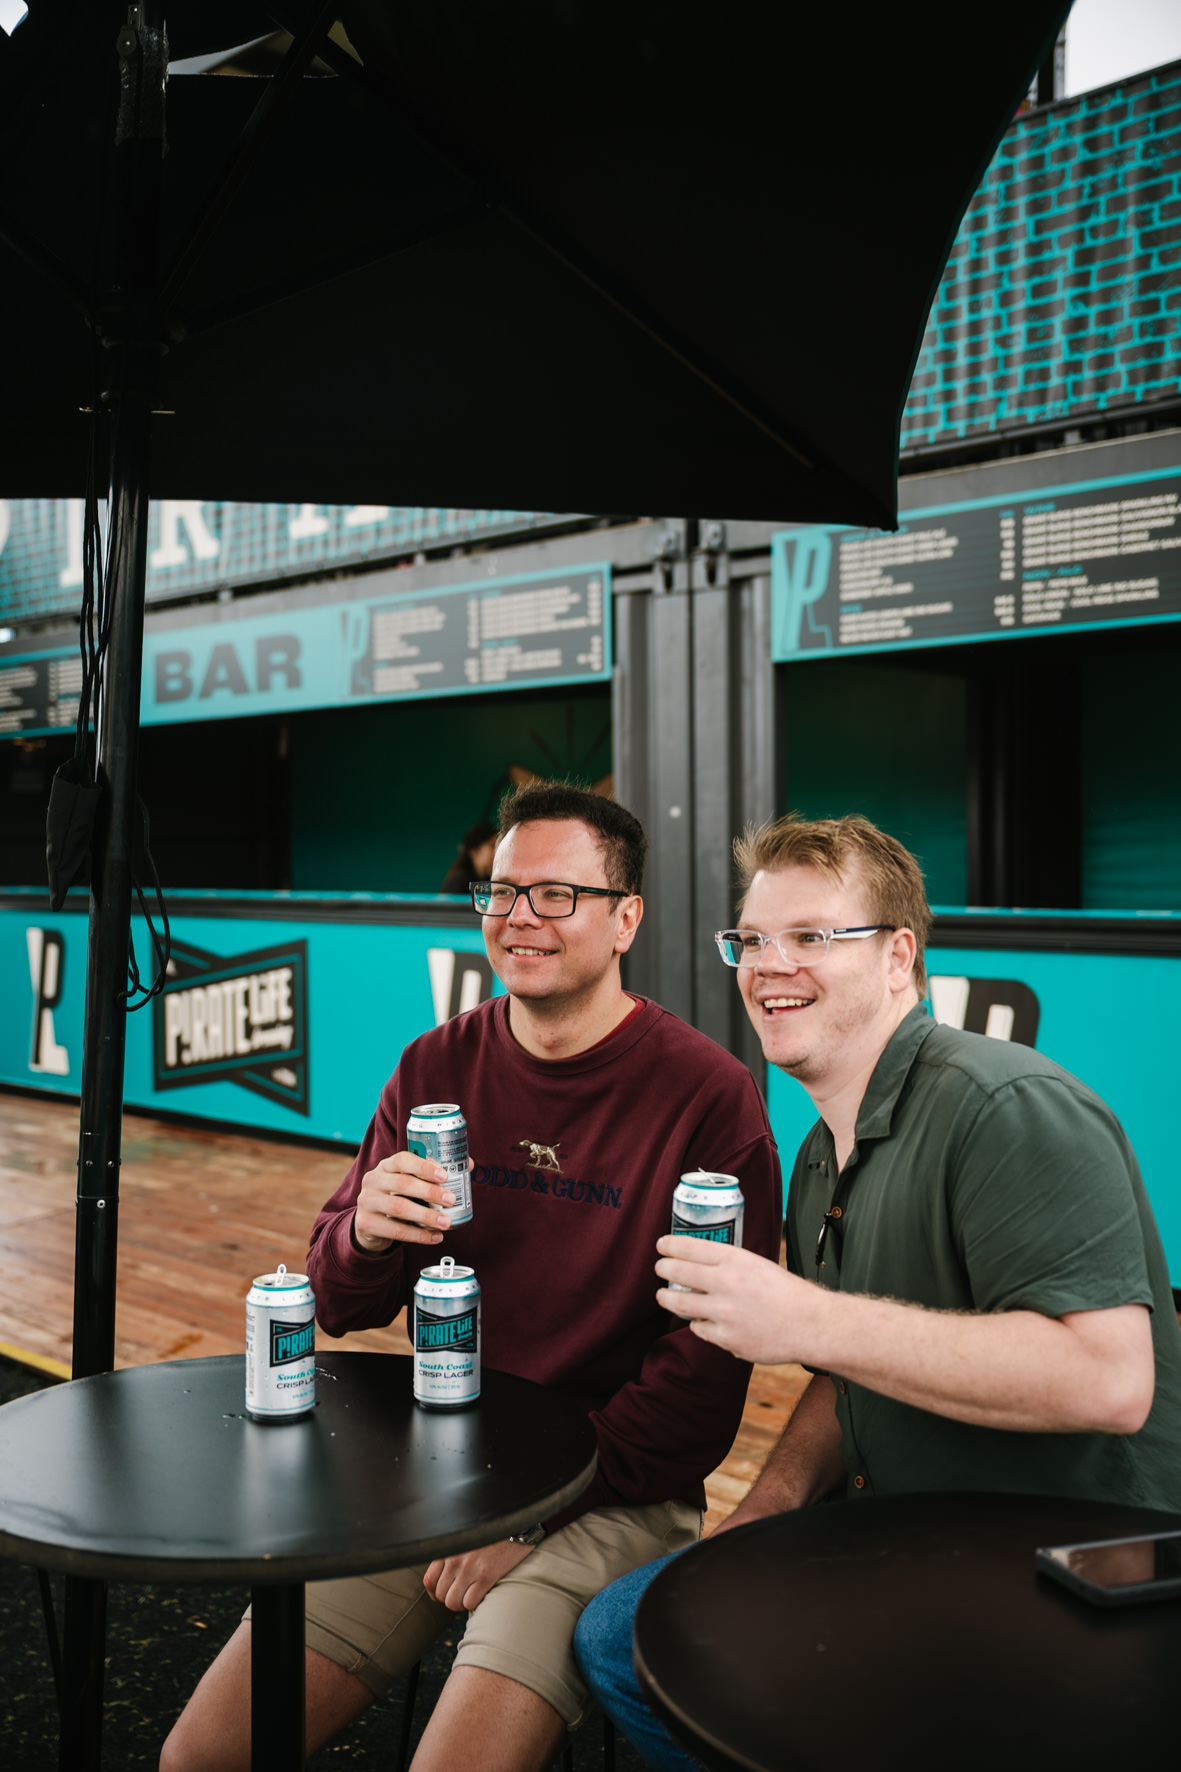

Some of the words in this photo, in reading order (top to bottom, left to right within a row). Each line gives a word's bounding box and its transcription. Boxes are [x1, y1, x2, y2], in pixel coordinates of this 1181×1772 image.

[154, 634, 303, 704] BAR
[472, 1165, 529, 1190] ODD
[530, 1172, 550, 1194] &
[419, 1360, 444, 1371] South
[418, 1369, 443, 1378] CRISP
[443, 1369, 474, 1379] LAGER
[276, 1379, 305, 1390] CRISP
